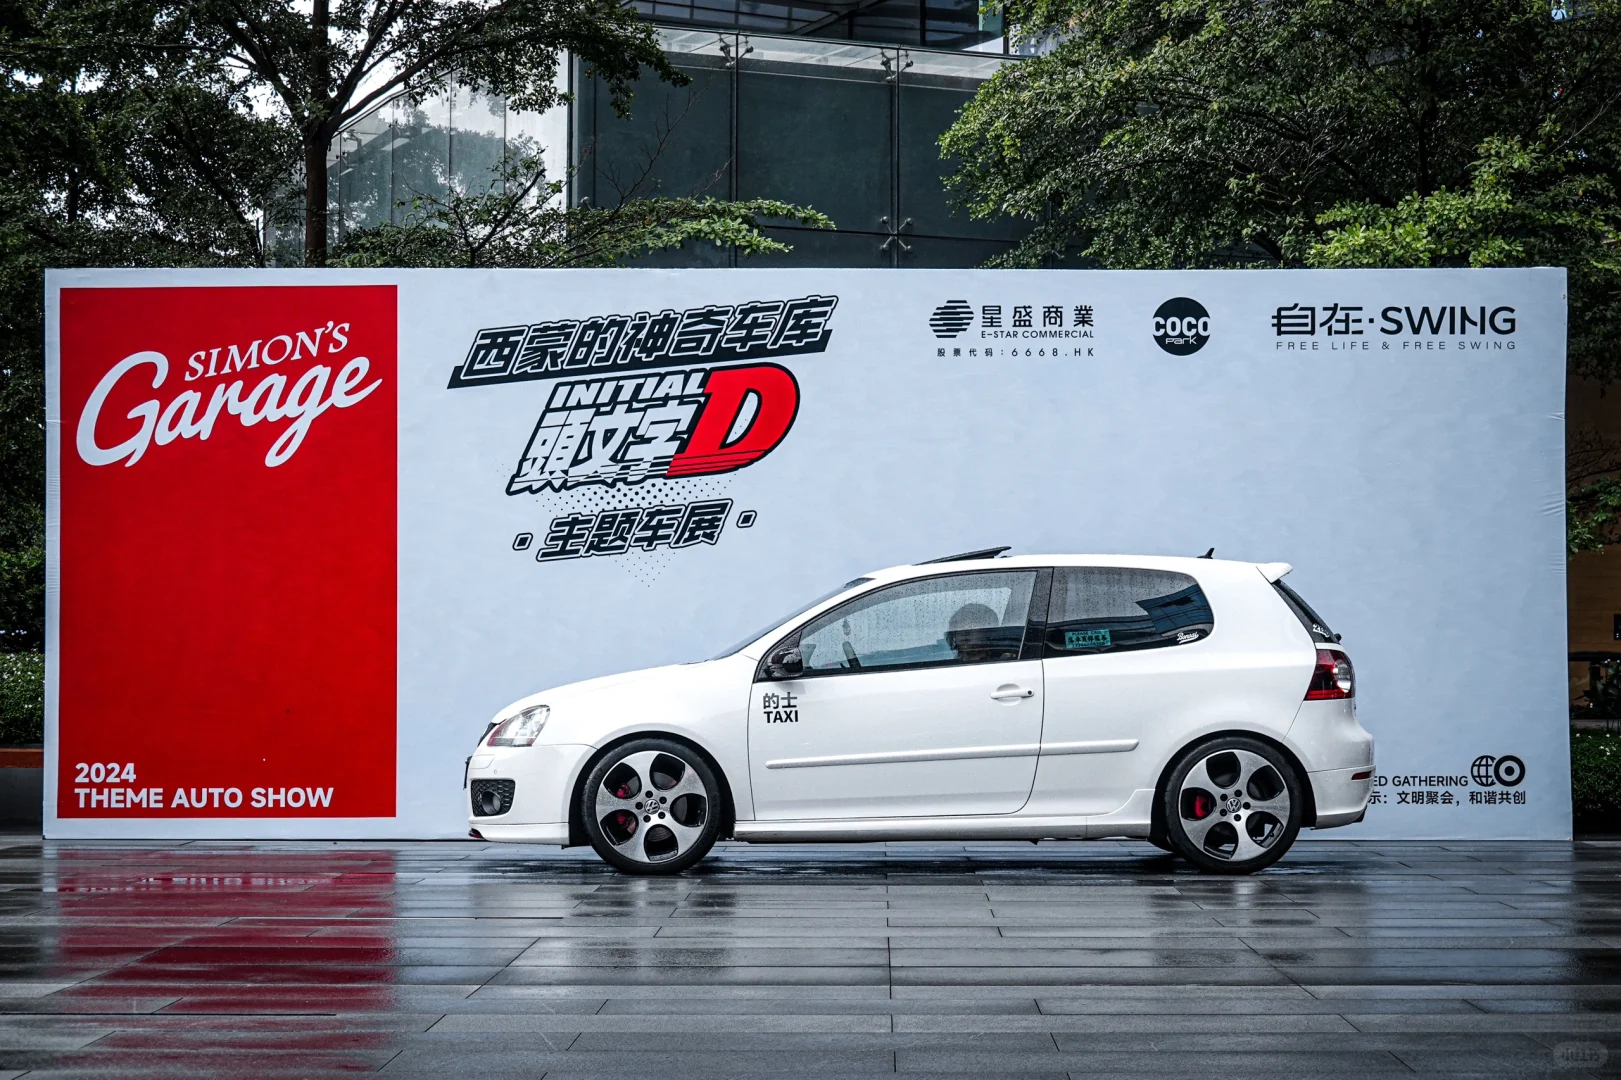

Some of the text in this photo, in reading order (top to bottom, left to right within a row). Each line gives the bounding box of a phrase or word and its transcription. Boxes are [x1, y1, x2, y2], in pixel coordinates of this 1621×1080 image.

[981, 305, 1094, 328] 星盛商業
[1152, 316, 1211, 337] COCO
[460, 296, 838, 380] 西蒙的神奇车库
[981, 331, 1094, 339] E-STAR COMMERCIAL
[1276, 341, 1516, 350] FREE LIFE & FREE SWING
[185, 320, 351, 381] SIMON'S
[547, 370, 706, 410] INITIAL
[75, 351, 383, 468] Garage
[763, 692, 798, 709] 的士
[763, 710, 799, 723] TAXI
[75, 762, 137, 783] 2024
[1392, 775, 1469, 787] GATHERING
[75, 787, 334, 808] THEME AUTO SHOW
